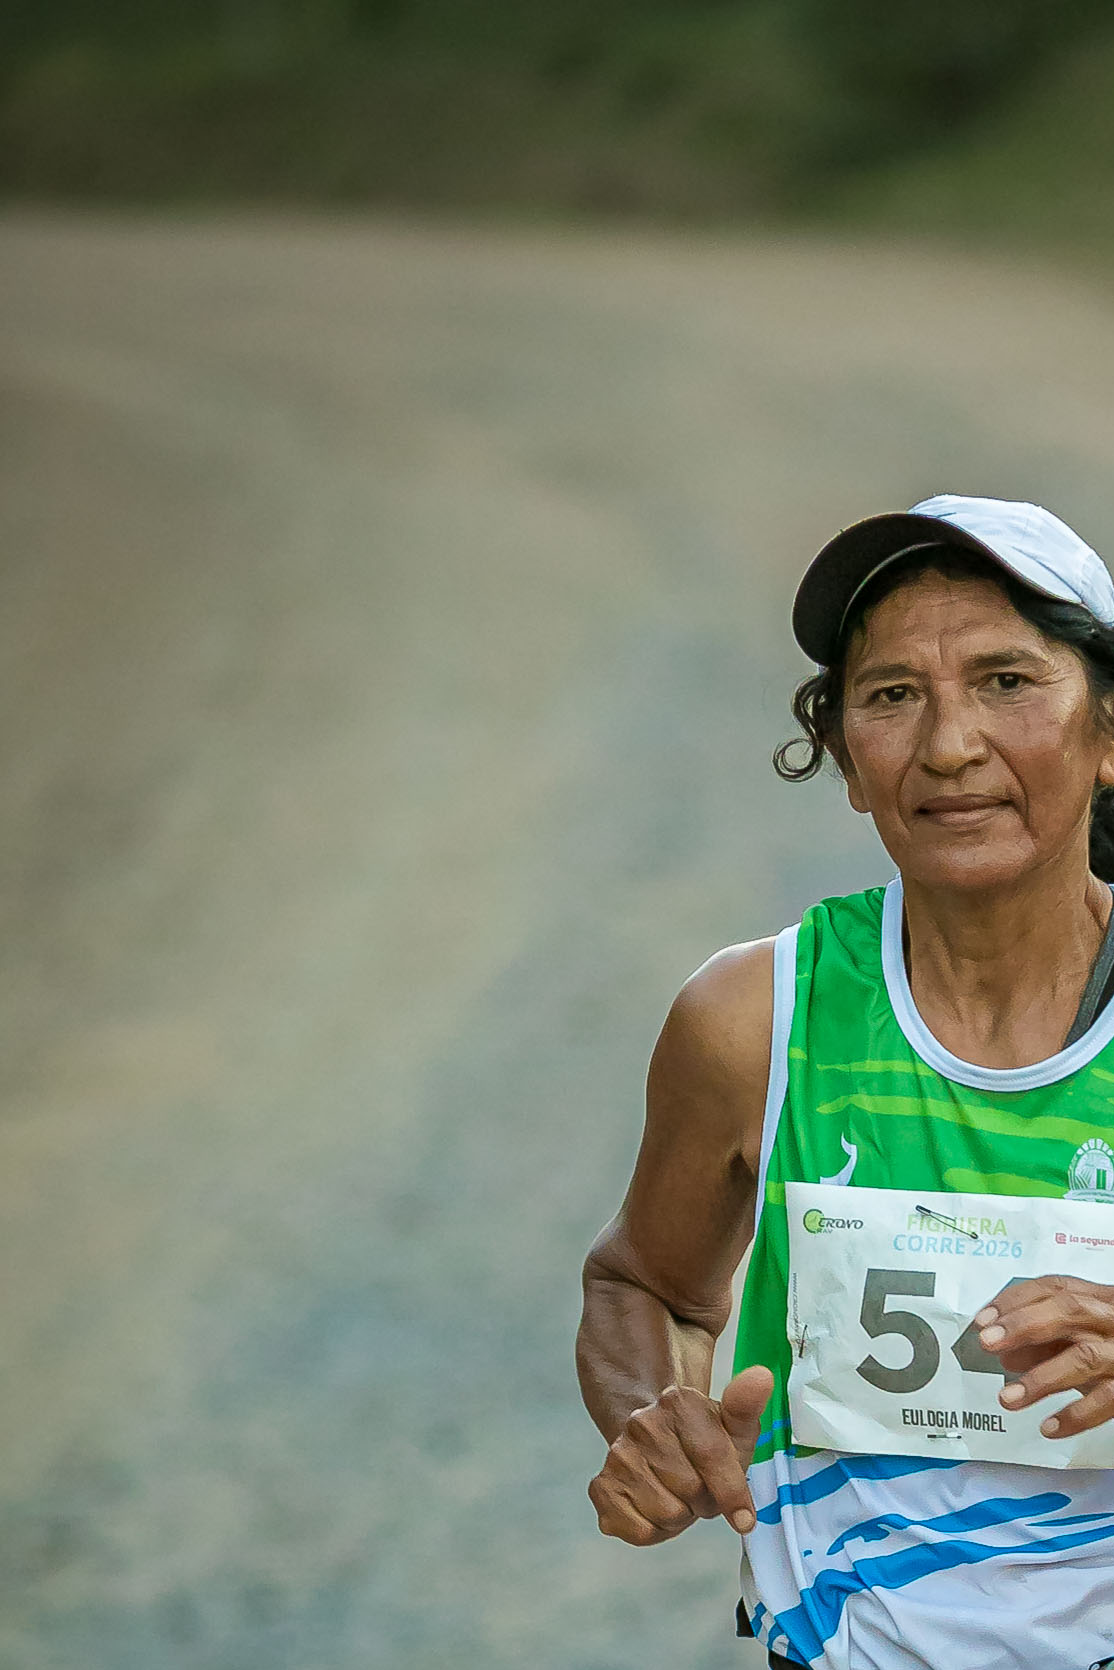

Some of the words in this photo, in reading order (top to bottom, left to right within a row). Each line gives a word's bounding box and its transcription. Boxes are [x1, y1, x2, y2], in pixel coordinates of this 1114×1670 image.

[907, 1213, 1007, 1236] FIGHIERA
[893, 1234, 965, 1255] CORRE
[972, 1239, 1022, 1259] 2026
[902, 1408, 959, 1429] EULOGIA
[962, 1411, 1007, 1433] MOREL
